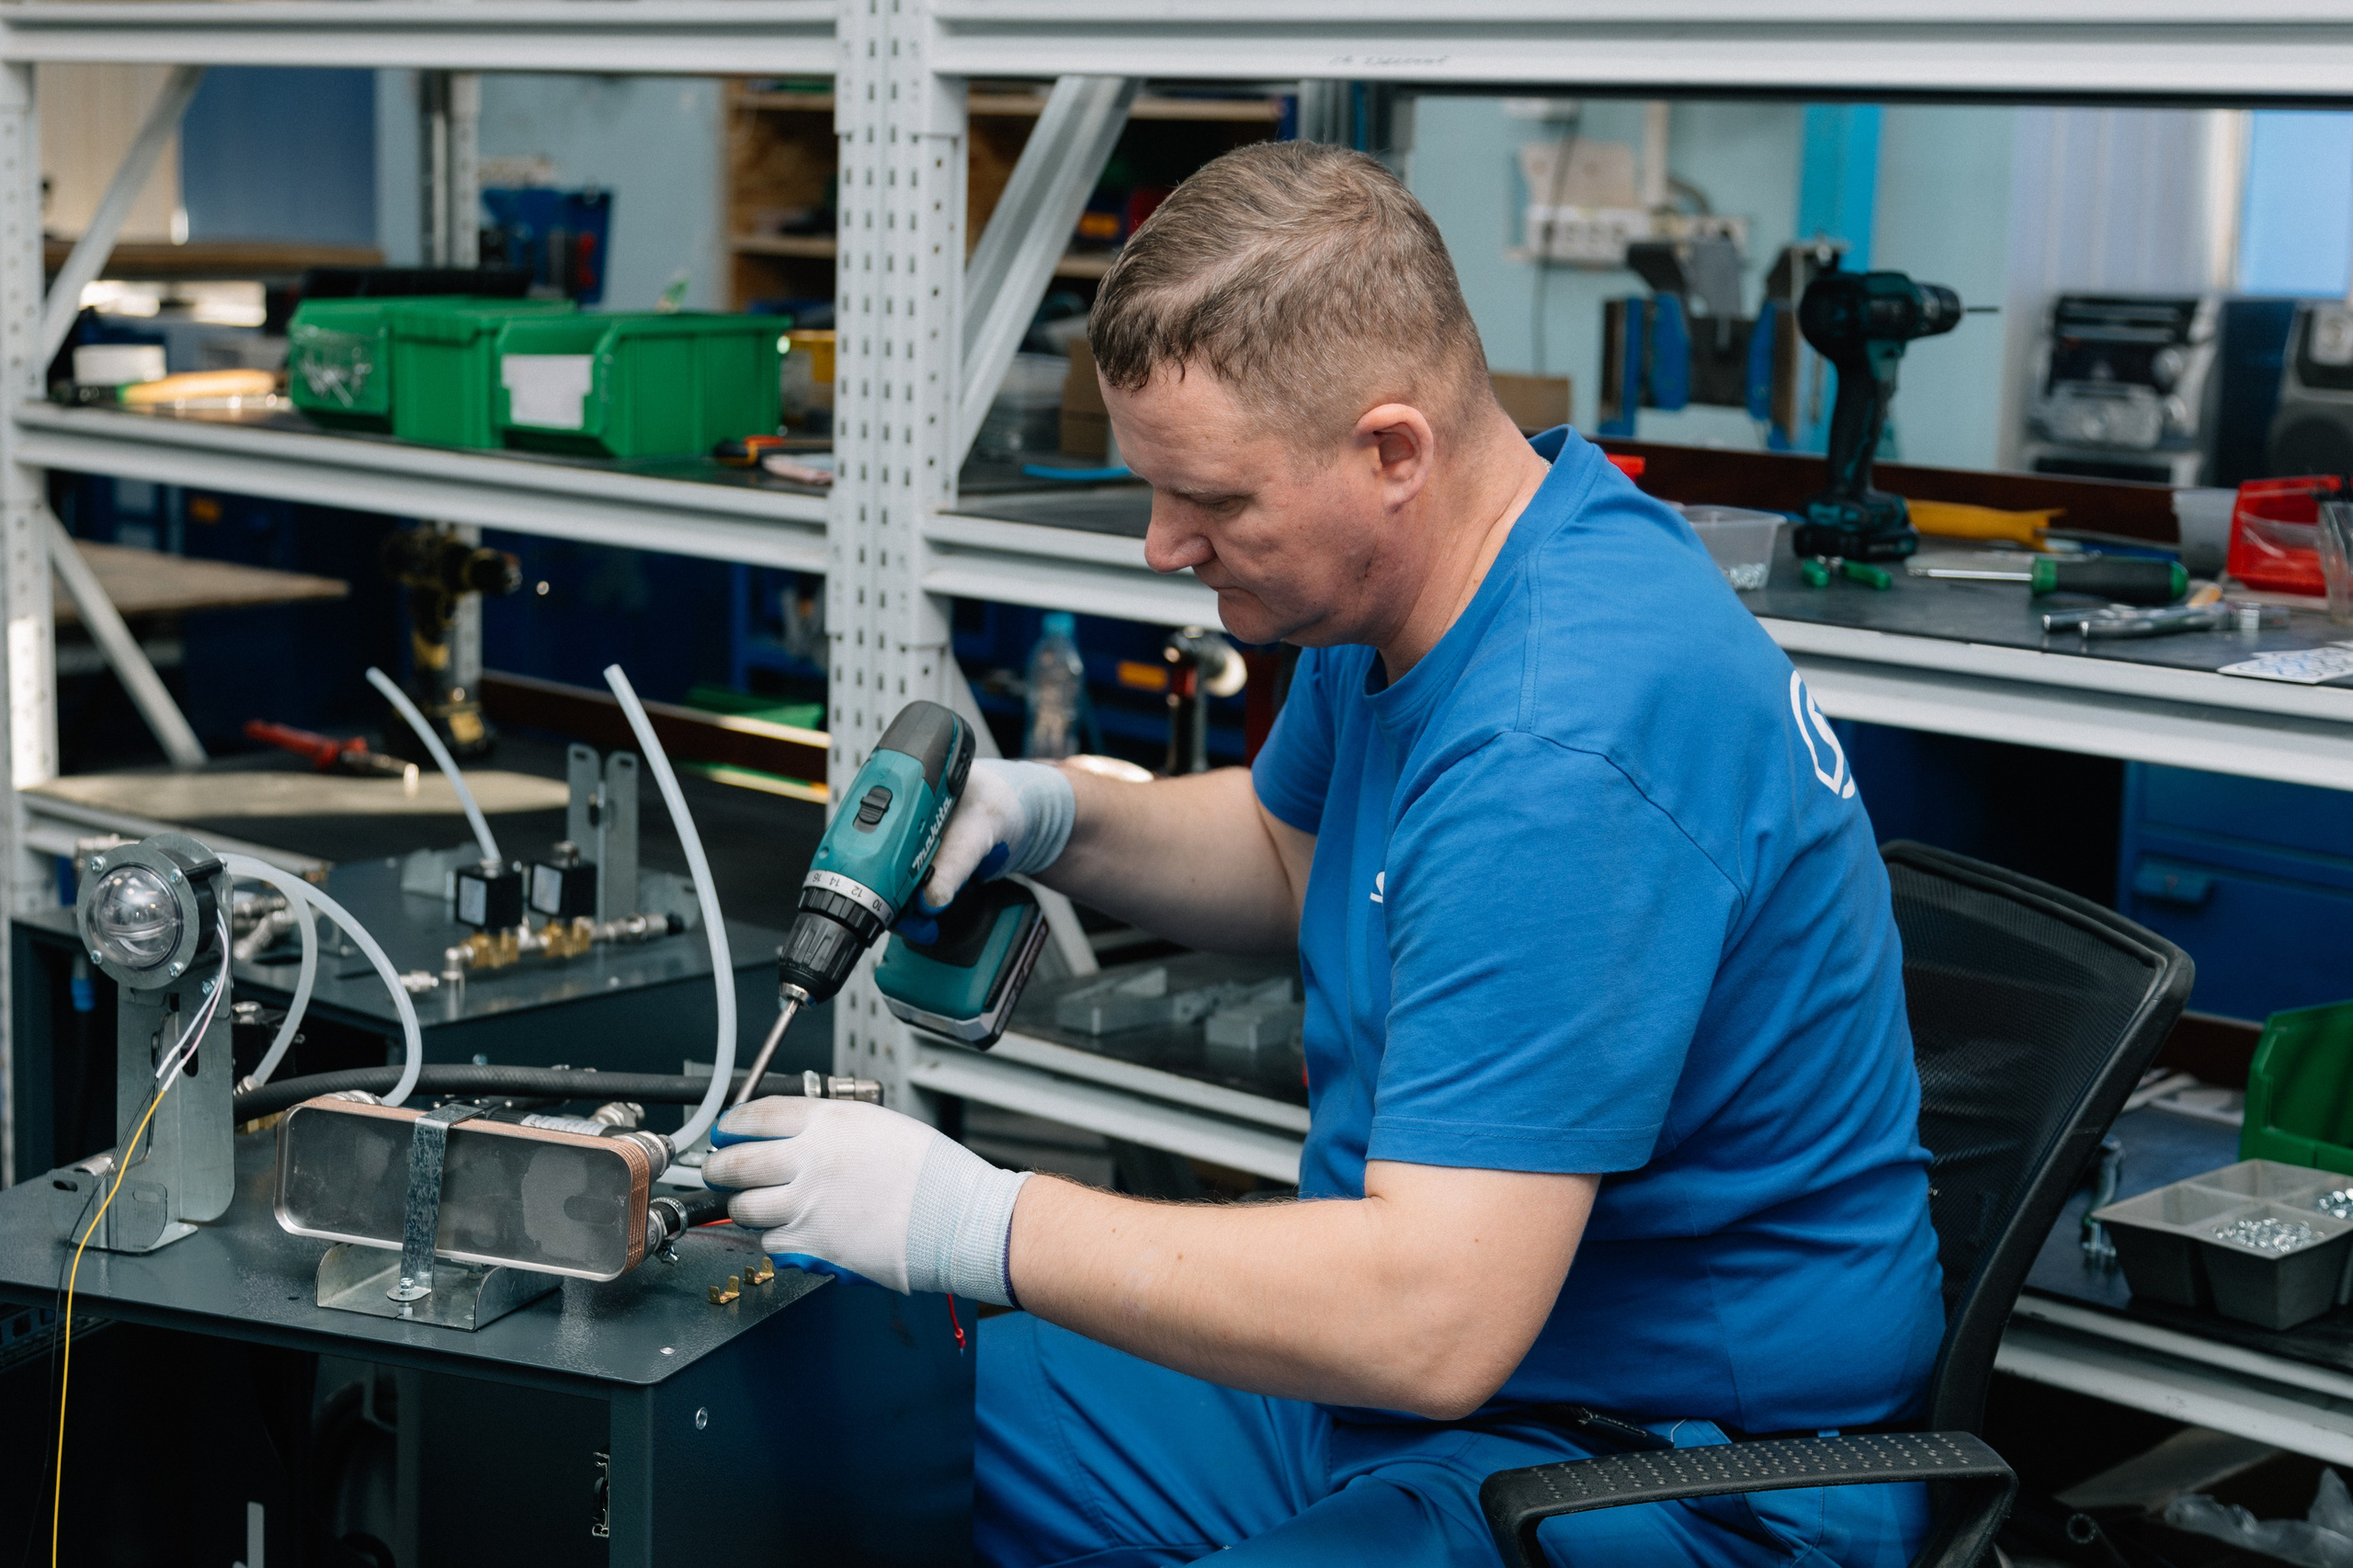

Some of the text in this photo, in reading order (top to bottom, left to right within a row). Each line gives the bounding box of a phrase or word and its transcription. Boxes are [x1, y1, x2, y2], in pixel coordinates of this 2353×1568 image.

[813, 872, 822, 883] 16
[829, 876, 840, 887] 14
[851, 886, 863, 898] 12
[871, 898, 883, 912] 10
